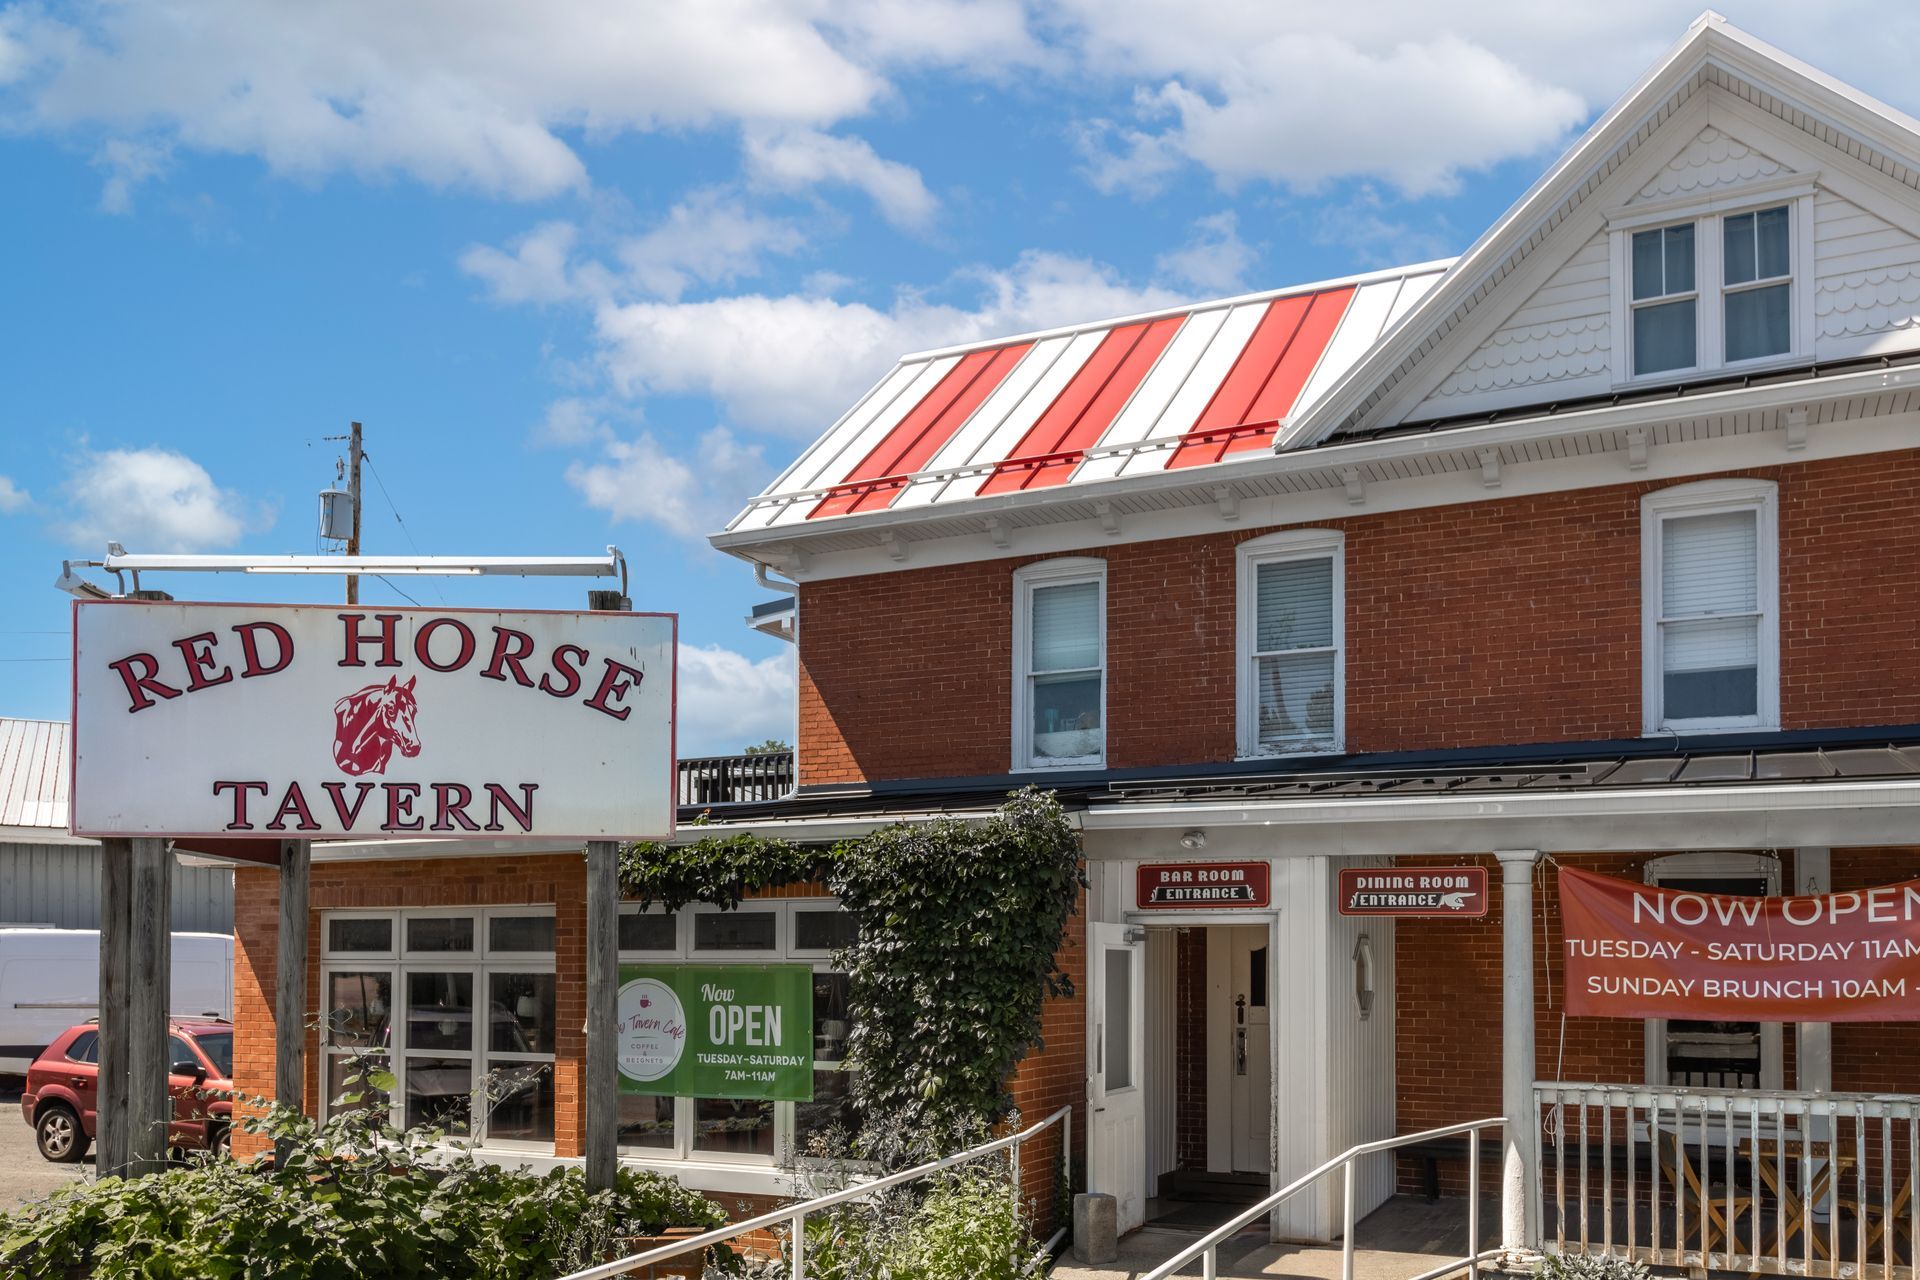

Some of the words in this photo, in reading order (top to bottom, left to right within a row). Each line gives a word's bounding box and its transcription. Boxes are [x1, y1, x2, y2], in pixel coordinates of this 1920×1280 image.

[109, 622, 294, 713] RED
[338, 614, 643, 721] HORSE
[213, 781, 538, 832] TAVERN
[1160, 870, 1192, 883] BAR
[1198, 869, 1244, 882] ROOM
[1356, 877, 1414, 889] DINING
[1420, 876, 1469, 889] ROOM
[1166, 887, 1240, 900] ENTRANCE
[1359, 894, 1437, 906] ENTRANCE
[1633, 892, 1763, 927] NOW
[1565, 939, 1684, 960] TUESDAY
[1707, 942, 1854, 962] SATURDAY
[1861, 939, 1920, 959] 11AM
[701, 984, 735, 1002] Now
[1587, 976, 1695, 997] SUNDAY
[1703, 979, 1823, 999] BRUNCH
[1831, 978, 1905, 998] 10AM
[628, 1014, 660, 1031] Tavern
[709, 1004, 782, 1046] OPEN
[697, 1053, 806, 1066] TUESDAY-SATURDAY
[725, 1070, 776, 1081] 7AM-11AM
